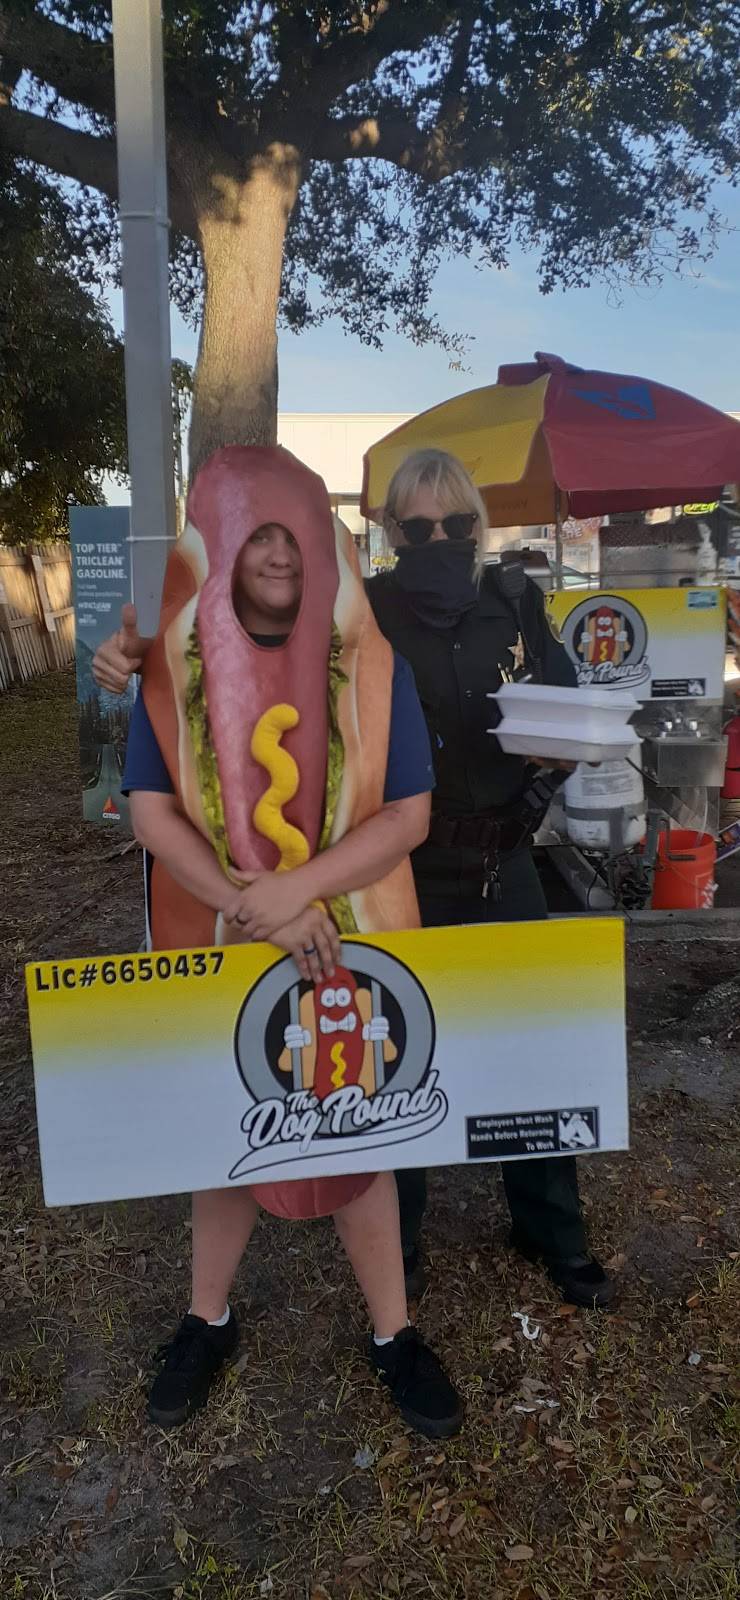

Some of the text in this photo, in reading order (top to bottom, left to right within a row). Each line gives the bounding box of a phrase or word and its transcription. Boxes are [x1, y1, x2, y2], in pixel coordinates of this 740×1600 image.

[75, 543, 95, 553] TOP
[77, 568, 128, 579] GASOLINE.
[595, 655, 648, 682] Pound
[35, 951, 225, 991] Lic#6650437
[287, 1090, 319, 1113] The
[241, 1070, 440, 1152] Dog Pound
[476, 1114, 554, 1129] Employees Must Wash
[470, 1129, 554, 1142] Hands Before Returning
[525, 1140, 555, 1151] To Work
